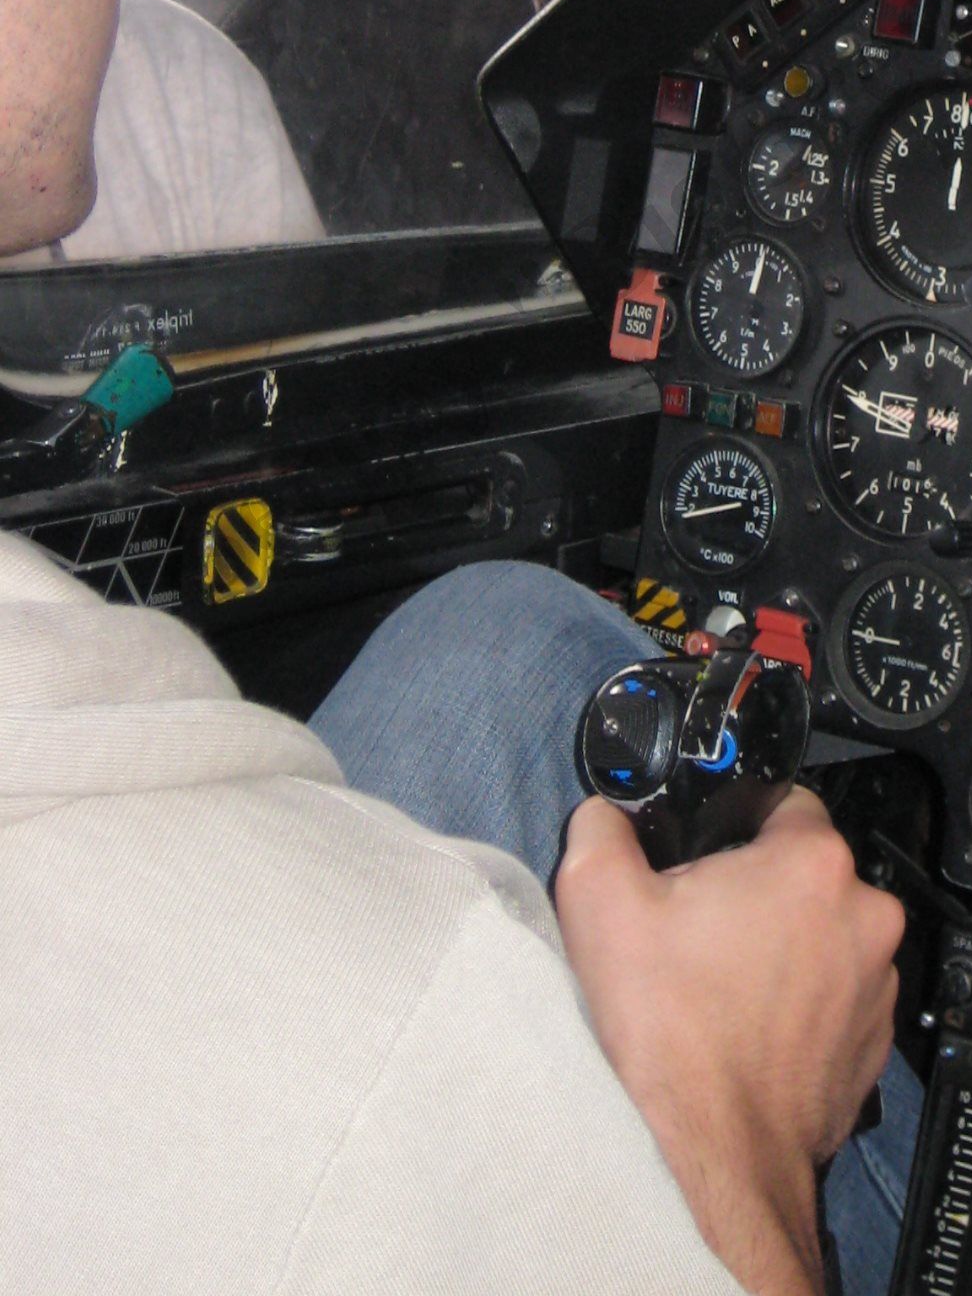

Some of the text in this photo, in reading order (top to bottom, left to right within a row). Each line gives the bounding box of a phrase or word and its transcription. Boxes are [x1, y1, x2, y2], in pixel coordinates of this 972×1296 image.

[732, 24, 758, 50] P A
[897, 138, 909, 158] 6
[768, 160, 780, 177] 2
[884, 173, 897, 194] 5
[890, 220, 901, 240] 4
[937, 266, 947, 286] 3
[624, 303, 652, 321] LARG
[625, 321, 647, 336] 550
[740, 342, 749, 357] 5
[729, 466, 737, 480] 6
[706, 481, 750, 502] TUYERE
[869, 477, 879, 496] 6
[902, 496, 913, 514] 5
[717, 589, 739, 604] VOIL
[912, 592, 923, 610] 2
[939, 612, 949, 630] 4
[941, 643, 951, 661] 6
[928, 670, 938, 687] 4
[899, 679, 911, 697] 2
